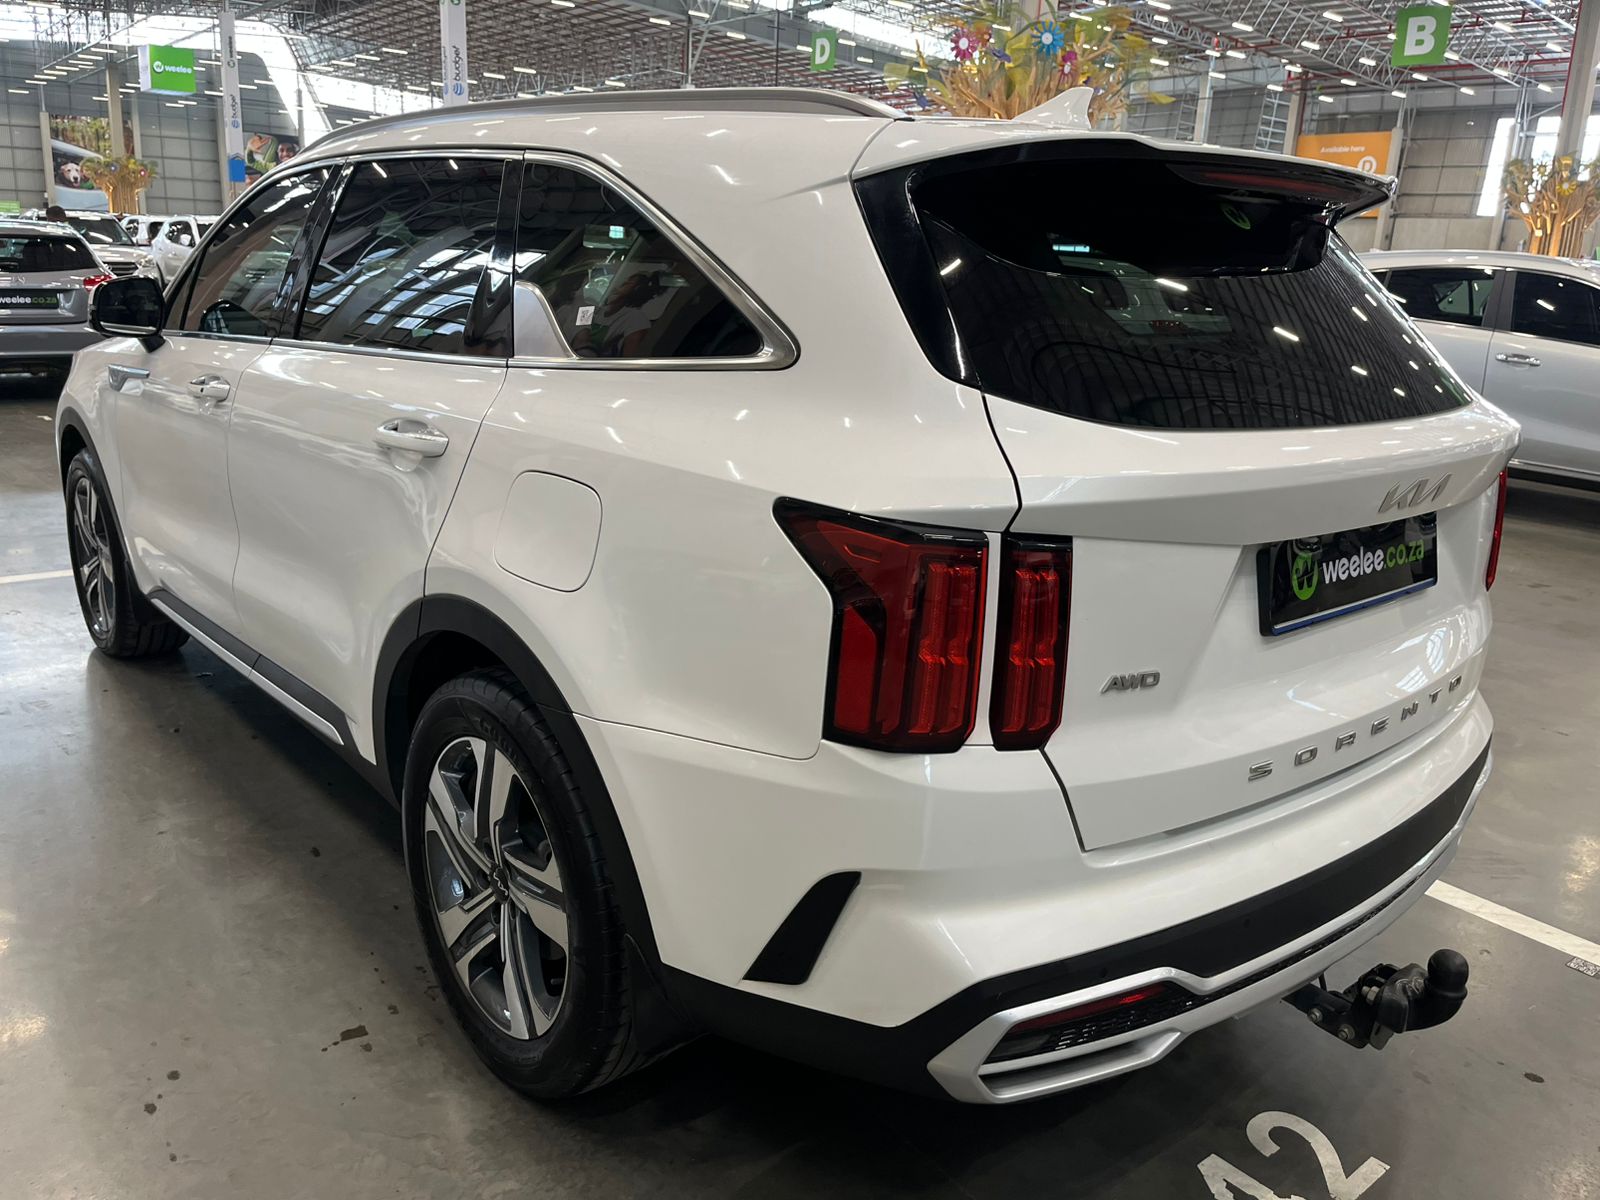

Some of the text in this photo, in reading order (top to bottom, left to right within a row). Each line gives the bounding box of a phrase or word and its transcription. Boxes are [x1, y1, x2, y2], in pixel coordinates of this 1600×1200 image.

[815, 37, 830, 65] D
[1404, 15, 1437, 57] B
[1100, 669, 1161, 694] AWD
[1247, 673, 1463, 782] SORENTO
